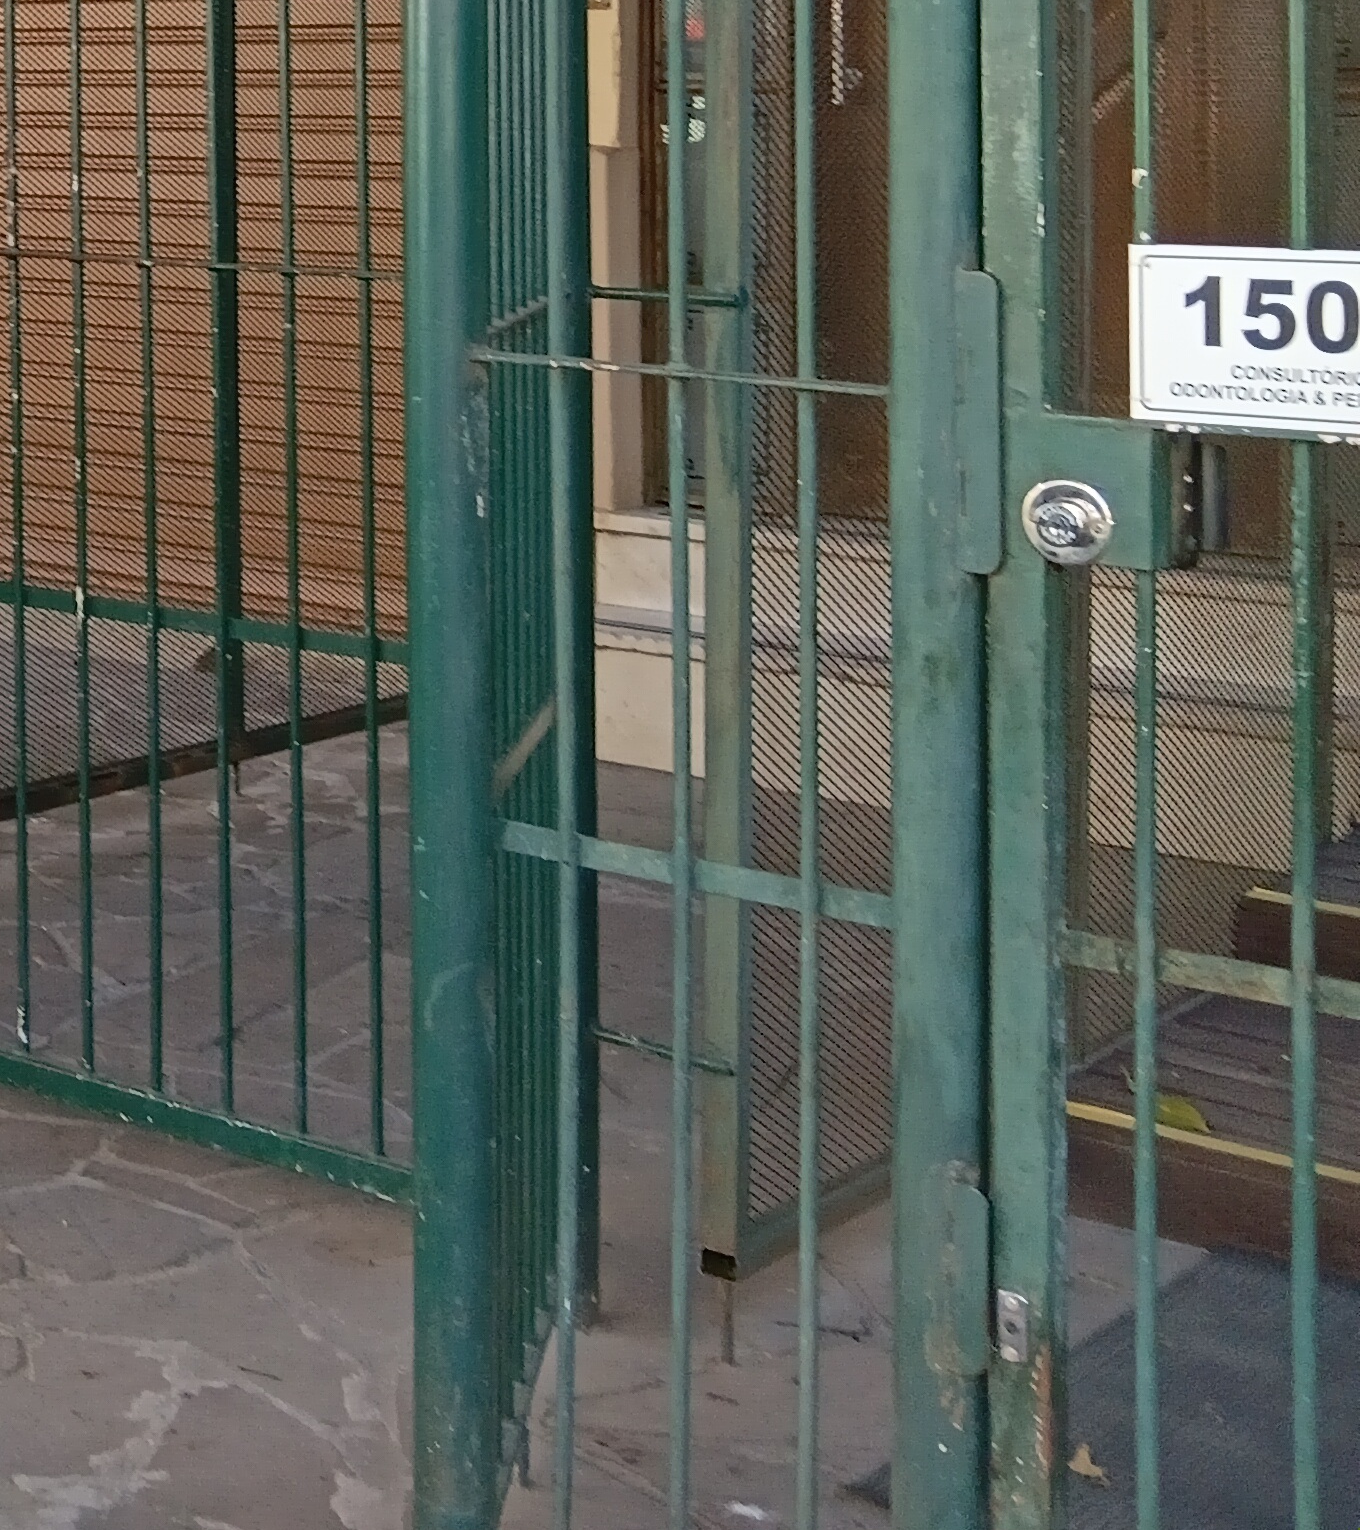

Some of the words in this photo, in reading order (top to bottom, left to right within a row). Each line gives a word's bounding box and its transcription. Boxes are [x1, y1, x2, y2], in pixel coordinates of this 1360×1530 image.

[1184, 275, 1359, 354] 150
[1169, 381, 1309, 405] ODONTOLOGIA
[1313, 390, 1327, 406] &
